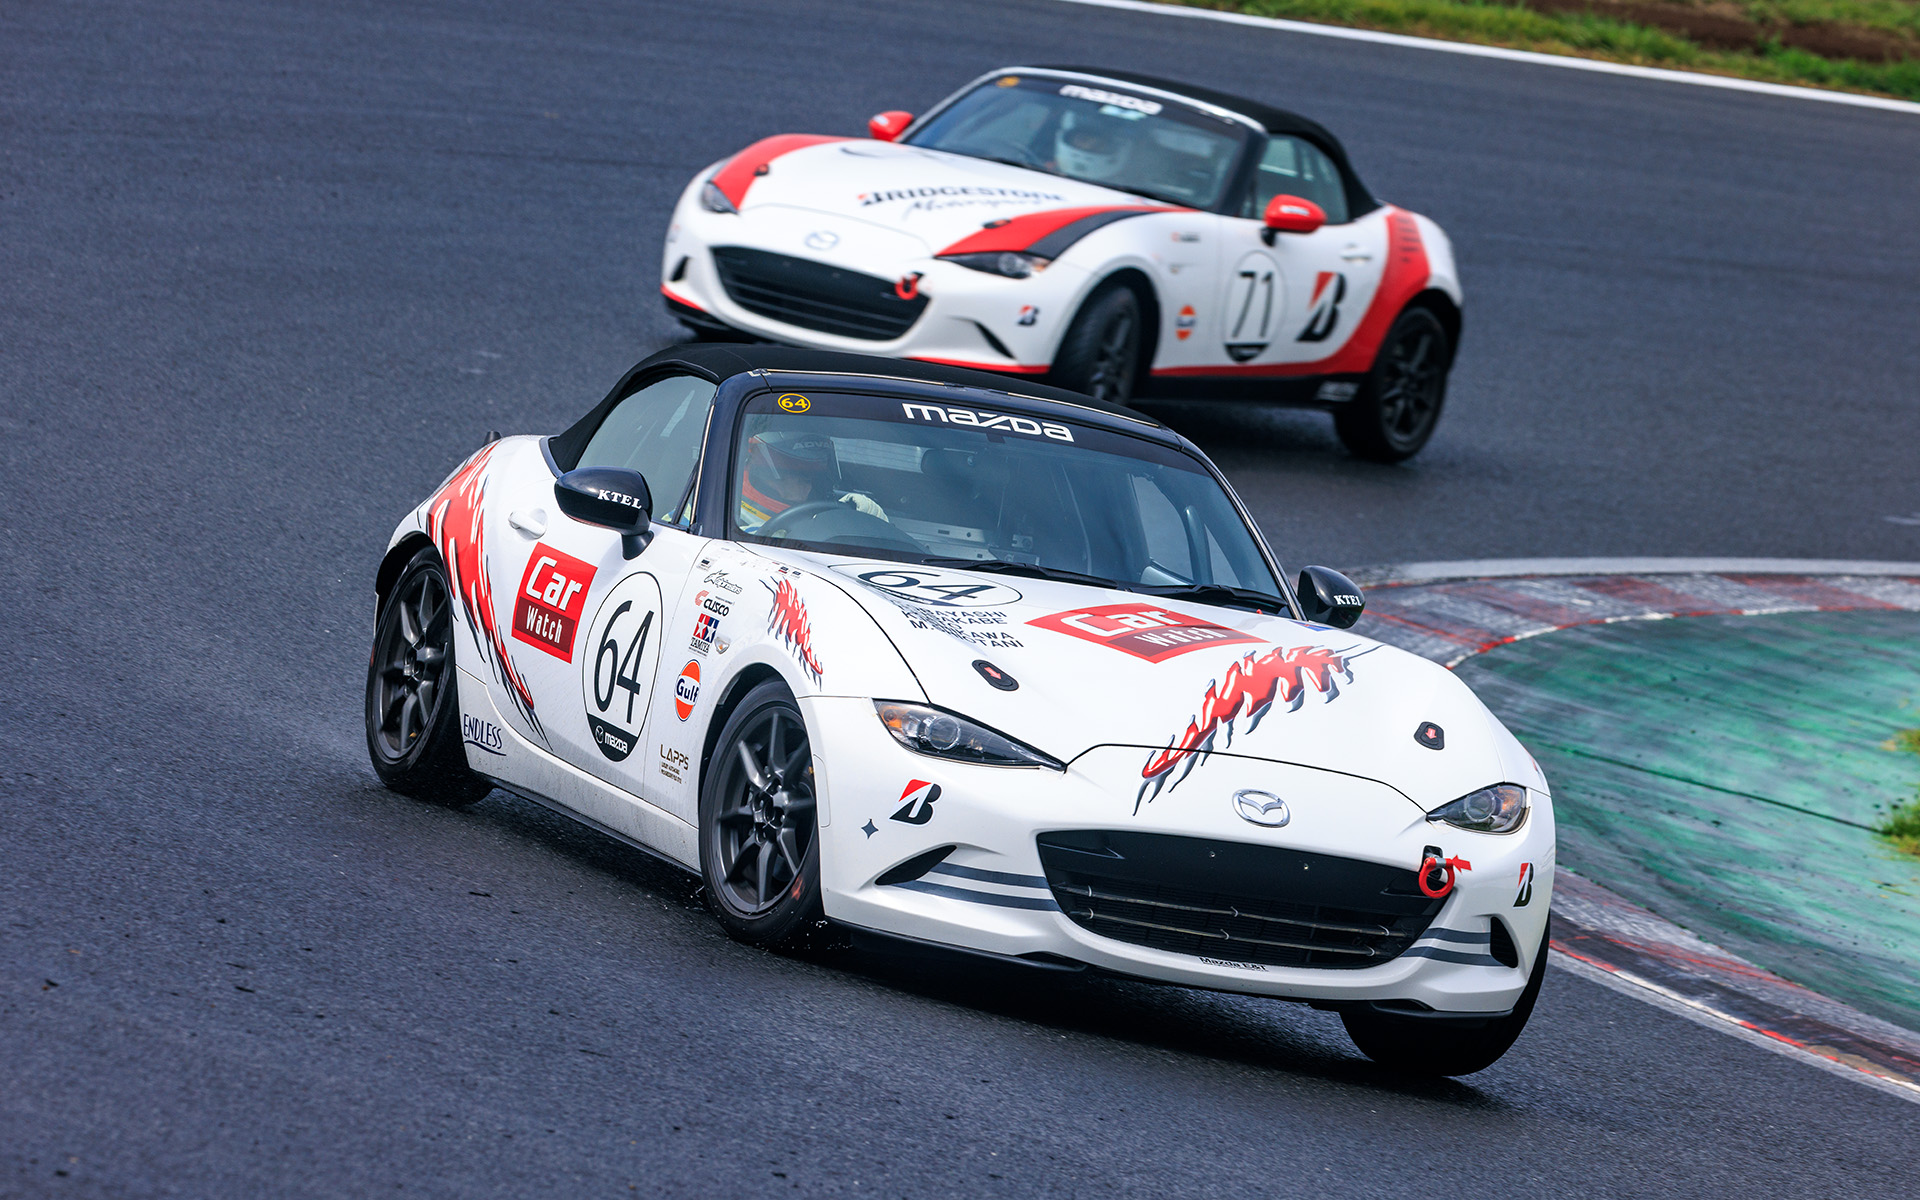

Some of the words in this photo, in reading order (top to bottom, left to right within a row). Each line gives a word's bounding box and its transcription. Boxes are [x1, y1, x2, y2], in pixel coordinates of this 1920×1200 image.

[1233, 270, 1275, 339] 71
[780, 397, 809, 411] 64
[902, 402, 1075, 443] mazda
[598, 489, 642, 509] KTEL
[525, 555, 583, 612] Car
[858, 570, 998, 601] 64
[703, 598, 730, 617] CUSCO
[525, 604, 563, 644] Watch
[1060, 610, 1183, 637] Car
[1134, 625, 1228, 647] Watch
[690, 636, 711, 654] TAMIYA
[593, 600, 655, 725] 64
[676, 677, 699, 703] Gulf
[463, 713, 503, 750] ENDLESS
[604, 733, 628, 755] mazda
[660, 743, 689, 771] LAPPS
